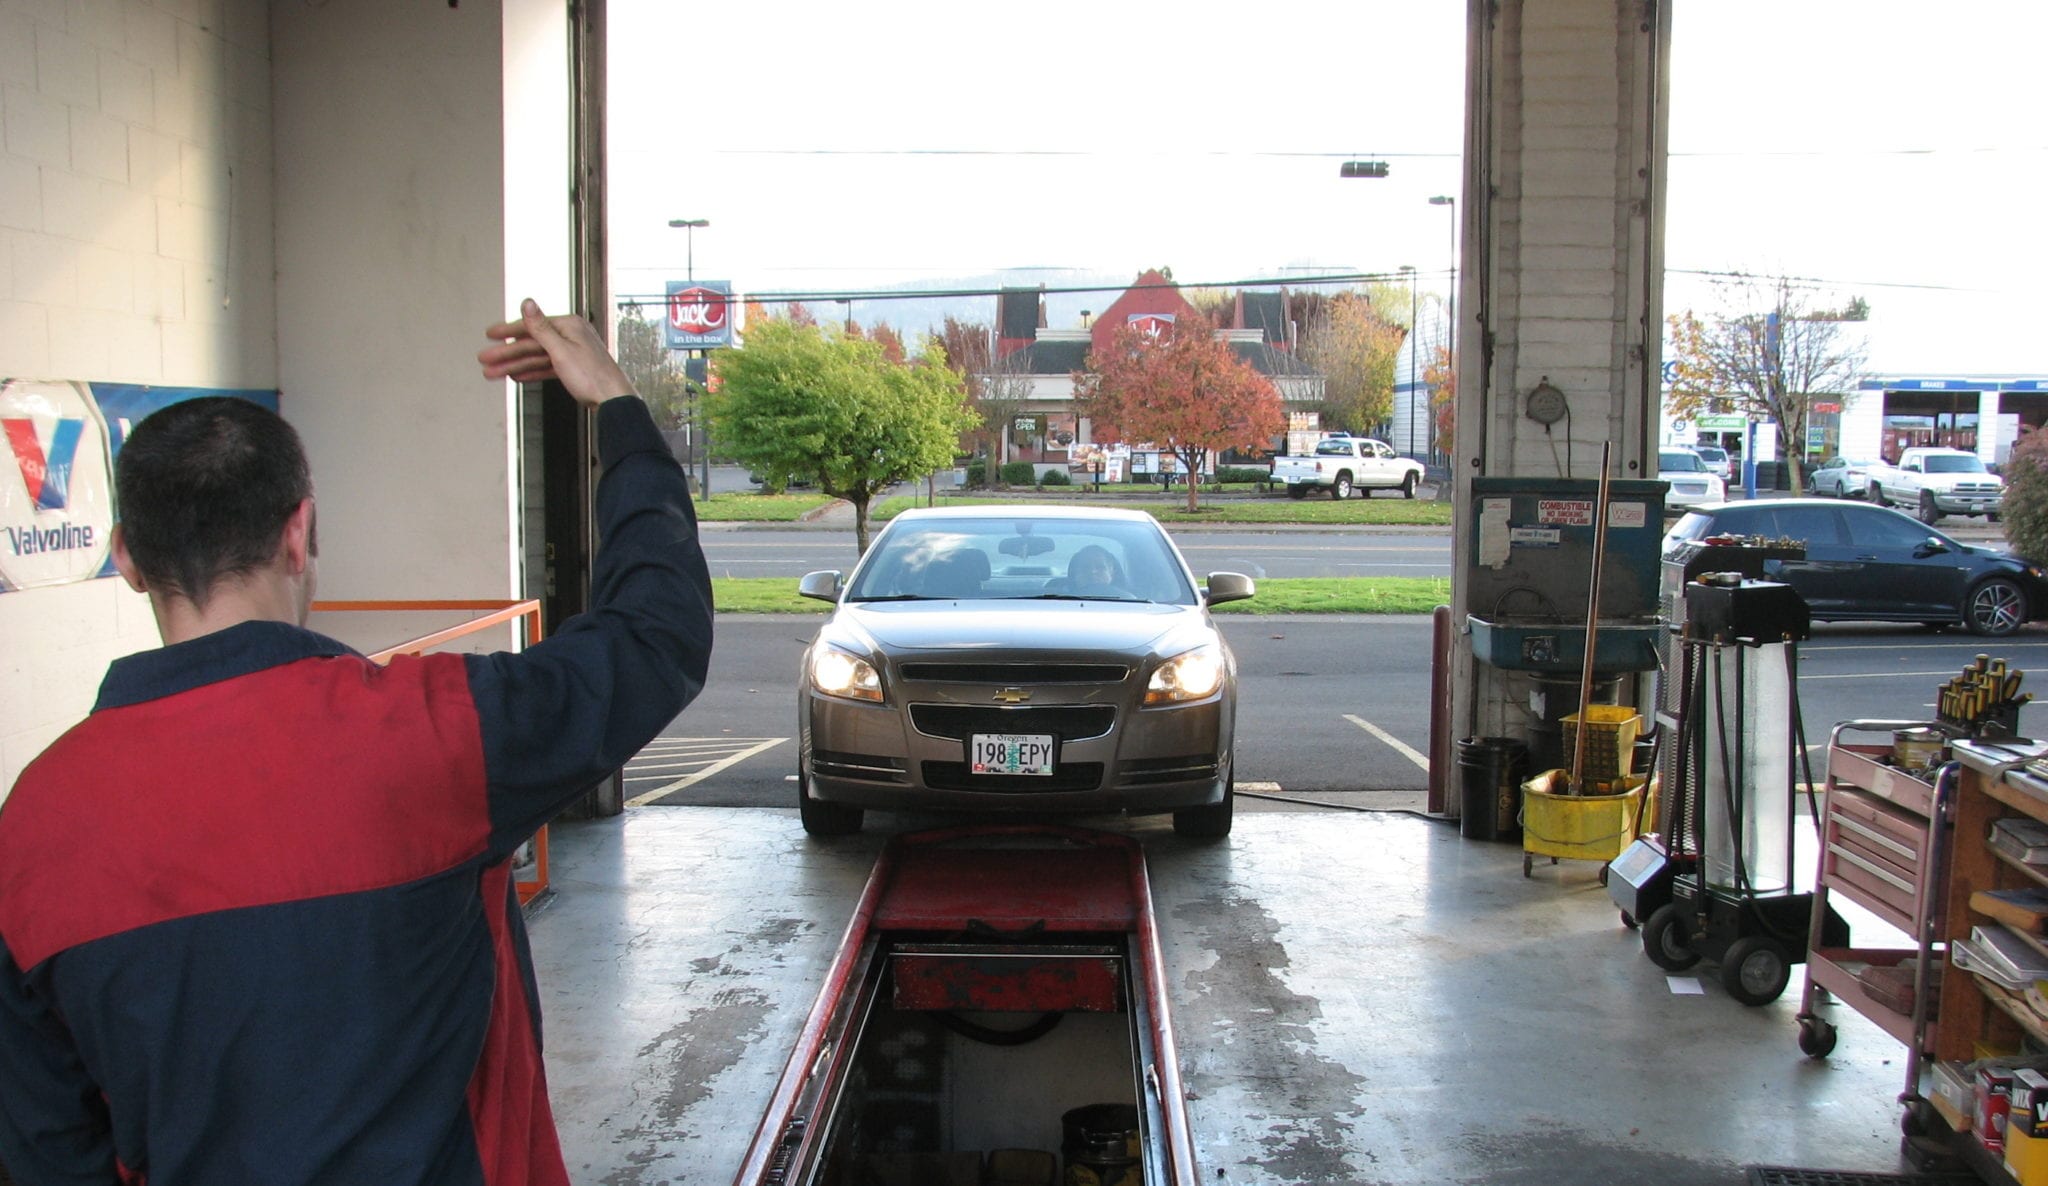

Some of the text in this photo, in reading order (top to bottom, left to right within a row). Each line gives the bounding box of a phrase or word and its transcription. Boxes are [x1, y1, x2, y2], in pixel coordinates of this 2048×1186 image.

[674, 335, 722, 343] in the box
[1015, 423, 1036, 431] OPEN
[1540, 501, 1592, 511] COMBUSTIBLE
[1547, 510, 1584, 518] NO SMOKING
[8, 521, 94, 556] Valvoline
[997, 735, 1028, 744] Oregon
[977, 742, 1051, 766] 198 EPY
